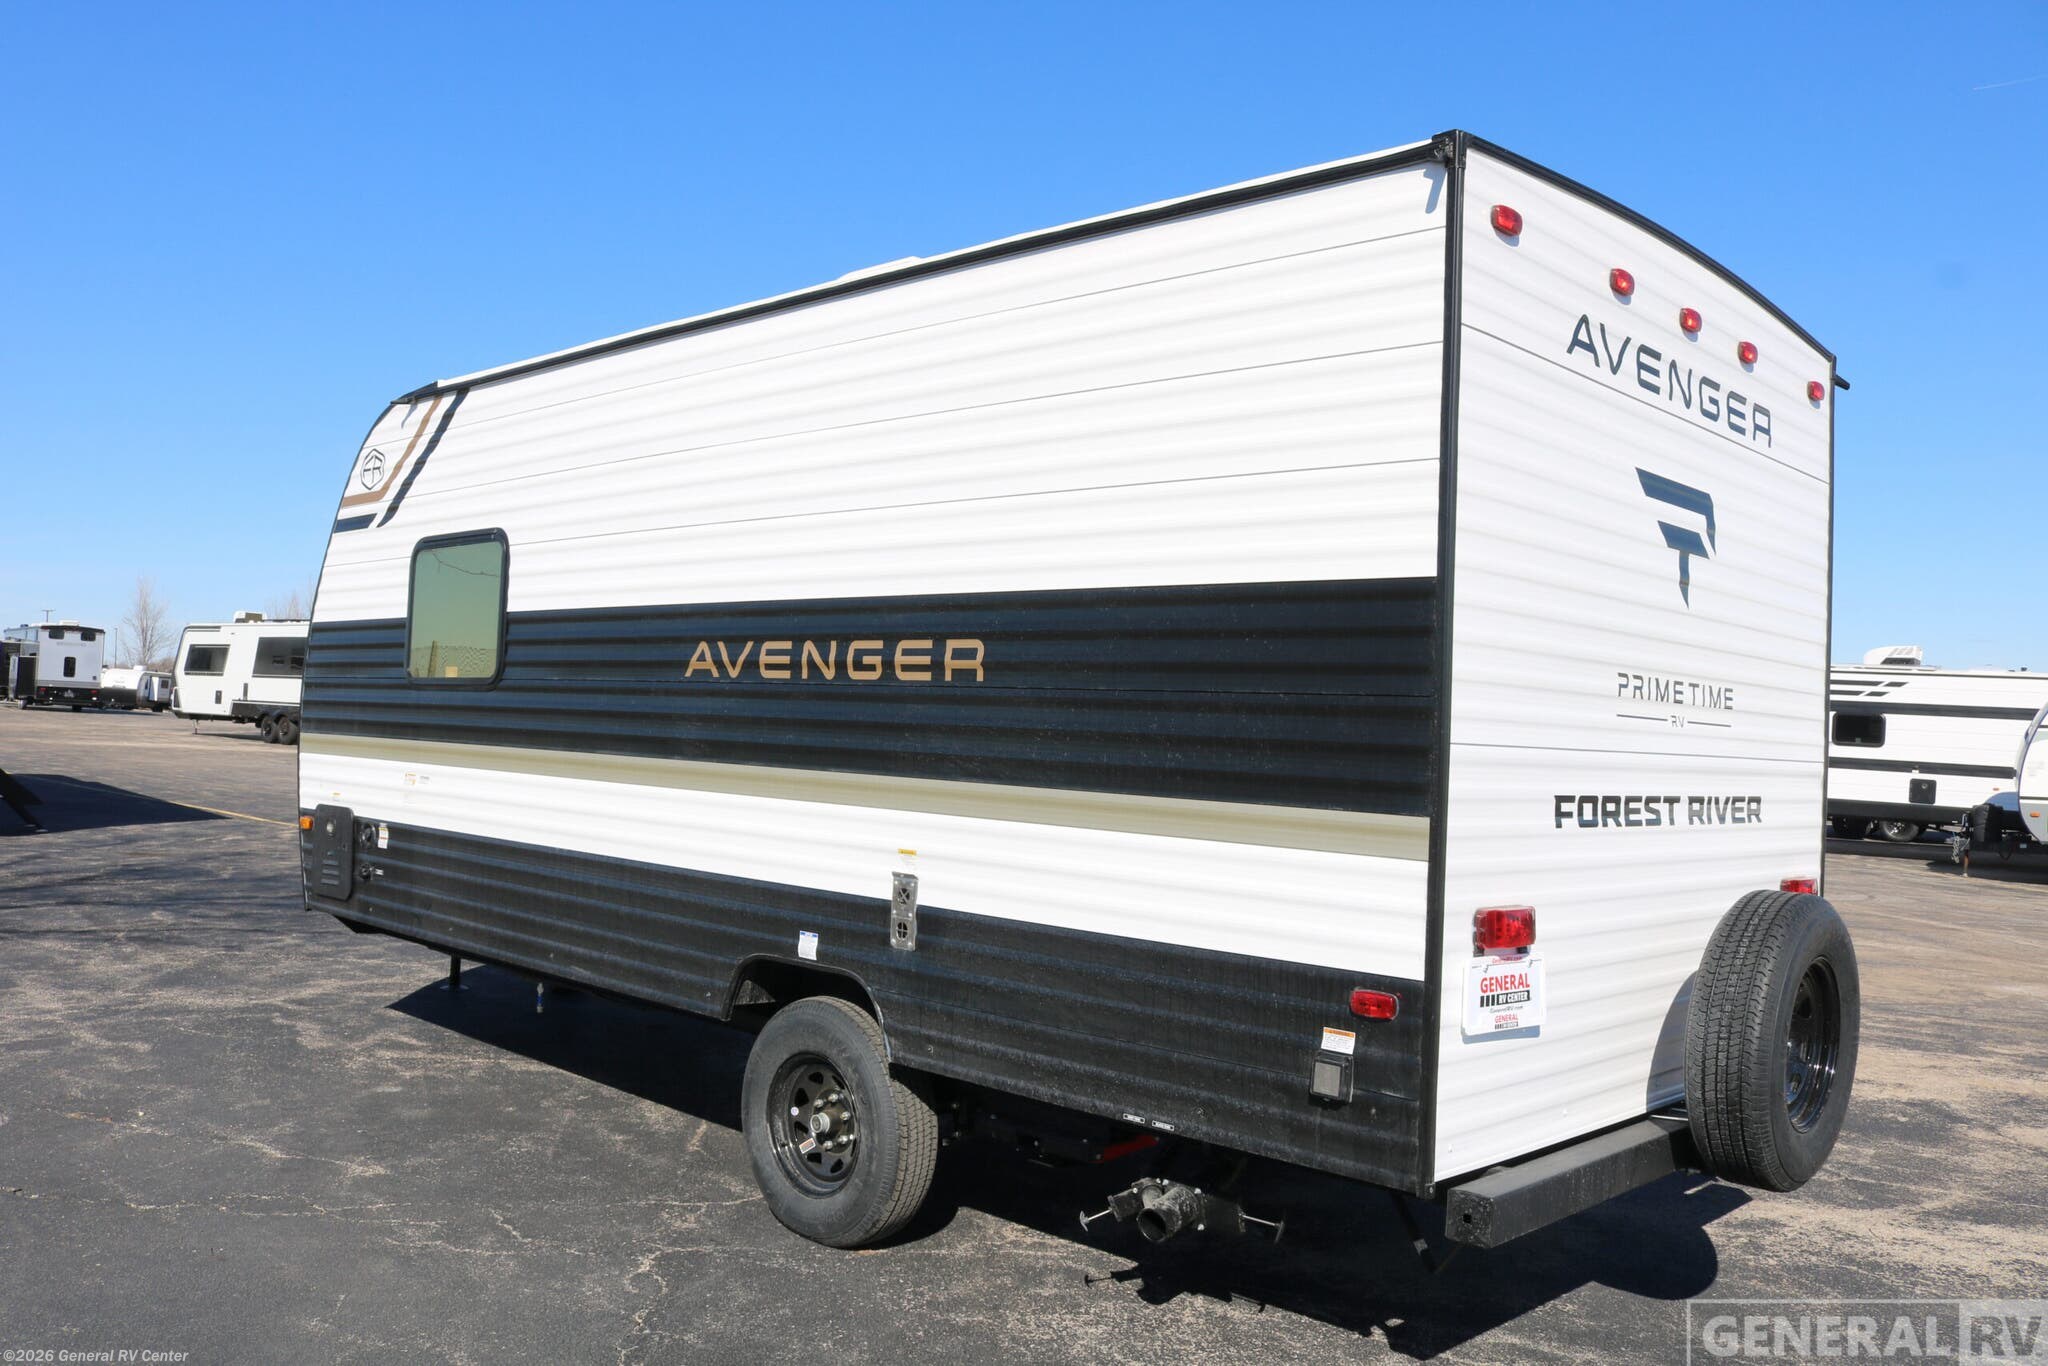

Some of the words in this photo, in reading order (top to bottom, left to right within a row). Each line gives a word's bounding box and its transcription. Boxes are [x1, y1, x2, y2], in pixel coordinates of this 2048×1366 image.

[1566, 313, 1772, 448] AVENGER
[684, 638, 985, 682] AVENGER
[1670, 715, 1685, 728] RV
[1554, 795, 1681, 829] FOREST
[1687, 795, 1763, 826] RIVER
[1480, 973, 1530, 994] GENERAL
